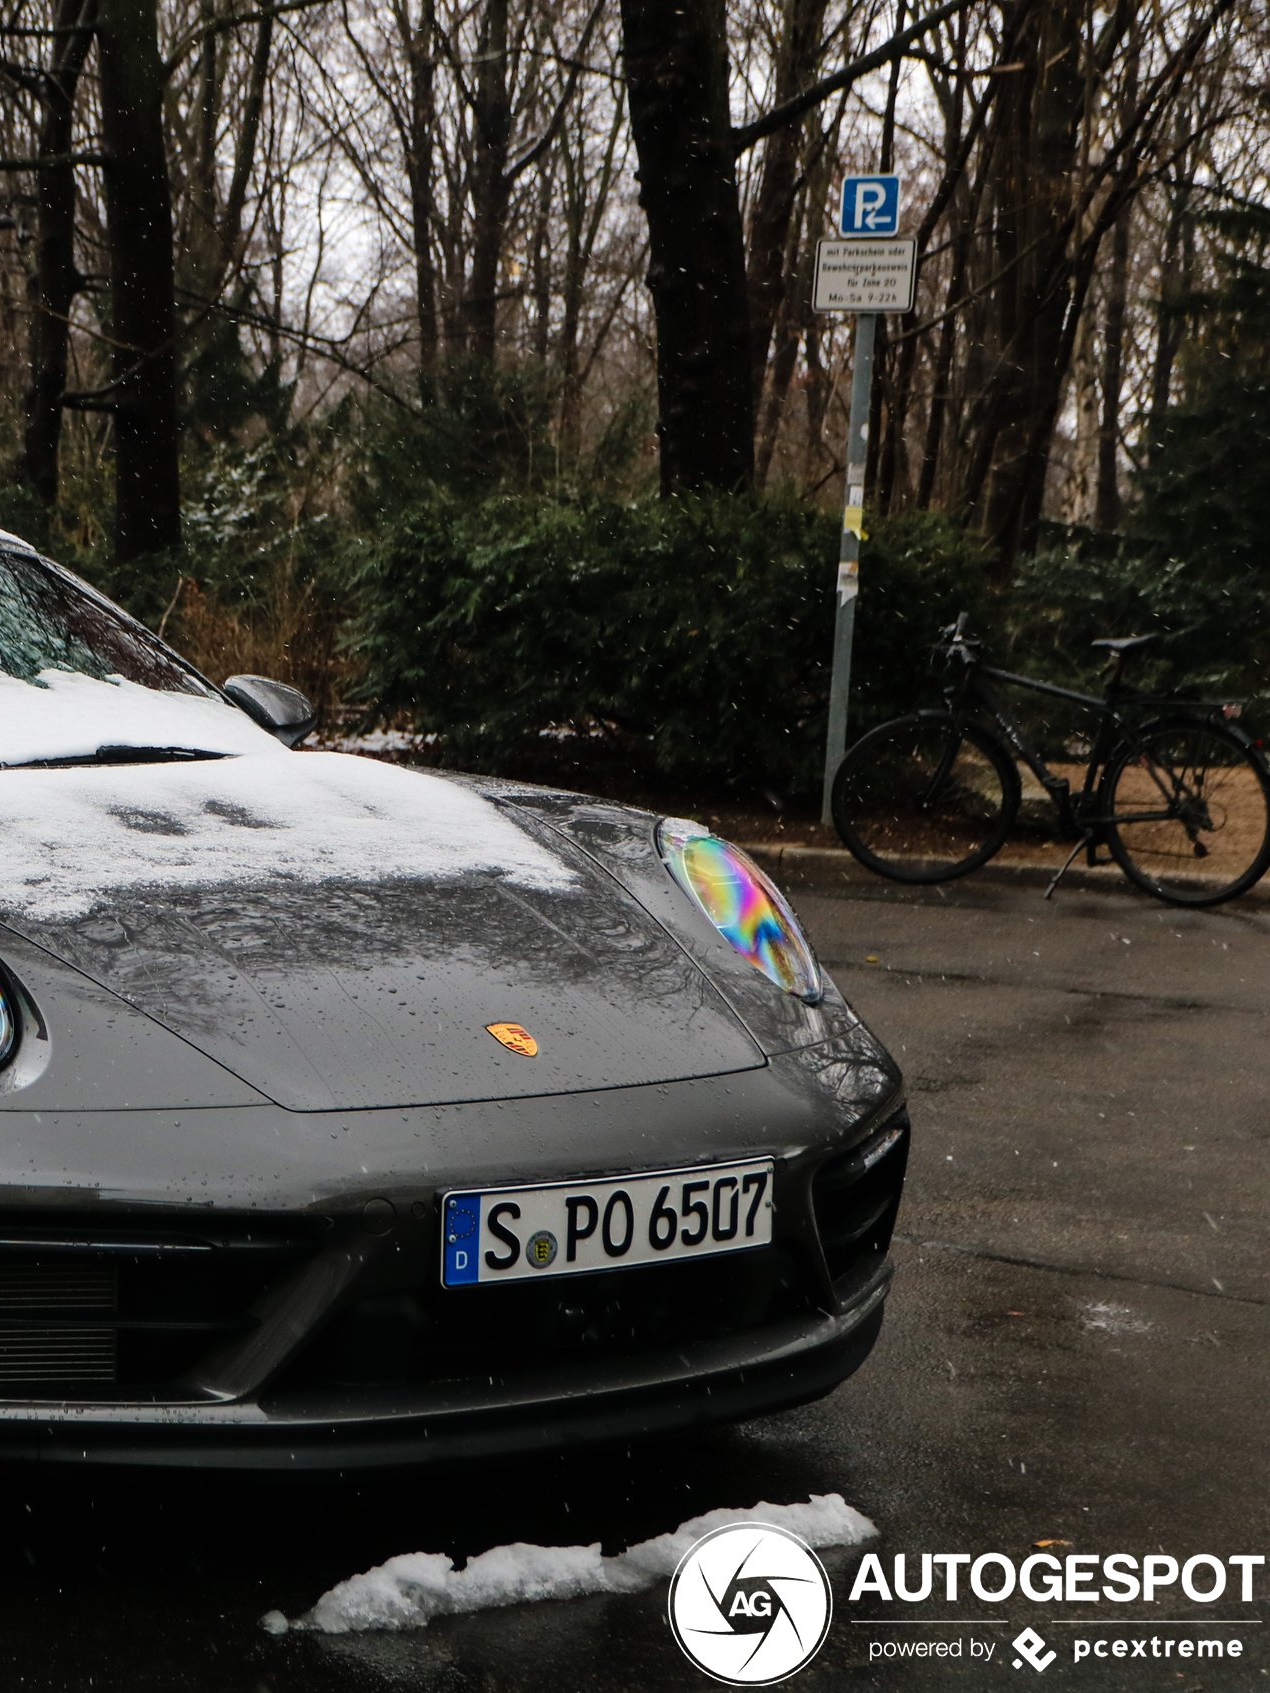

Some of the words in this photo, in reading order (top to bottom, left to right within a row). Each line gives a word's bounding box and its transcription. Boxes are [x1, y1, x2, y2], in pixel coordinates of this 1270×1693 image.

[854, 182, 887, 229] P
[827, 247, 840, 257] mit
[843, 247, 885, 257] Parkschein
[888, 246, 906, 256] oder
[822, 262, 908, 274] Bewohnerparkausweis
[847, 278, 858, 288] für
[862, 277, 881, 288] Zone
[883, 278, 897, 287] 20
[484, 1201, 522, 1270] S
[565, 1189, 635, 1262] PO
[648, 1171, 768, 1251] 6507
[455, 1250, 468, 1270] D
